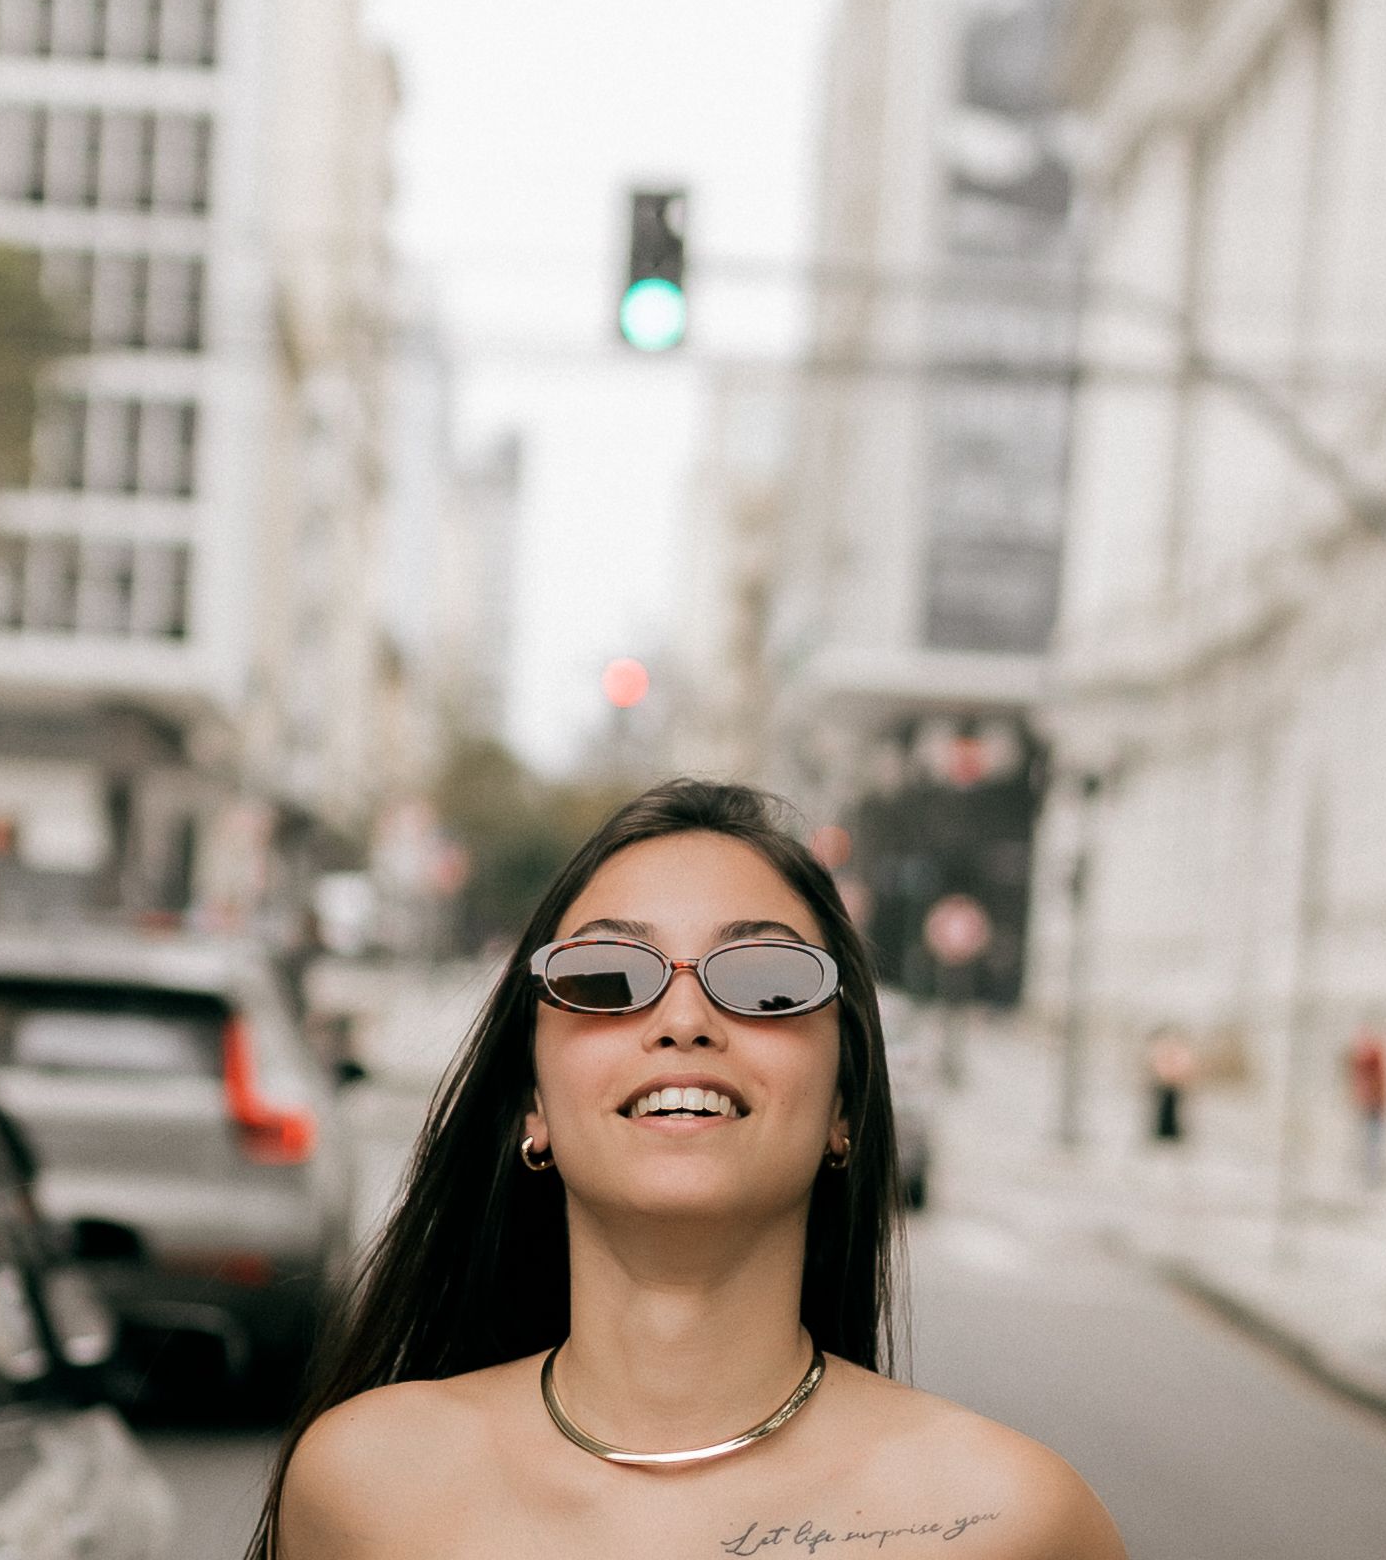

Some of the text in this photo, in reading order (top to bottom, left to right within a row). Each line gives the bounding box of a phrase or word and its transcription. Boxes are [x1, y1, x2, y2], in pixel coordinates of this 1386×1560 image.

[720, 1511, 1002, 1557] Let life surprise you
